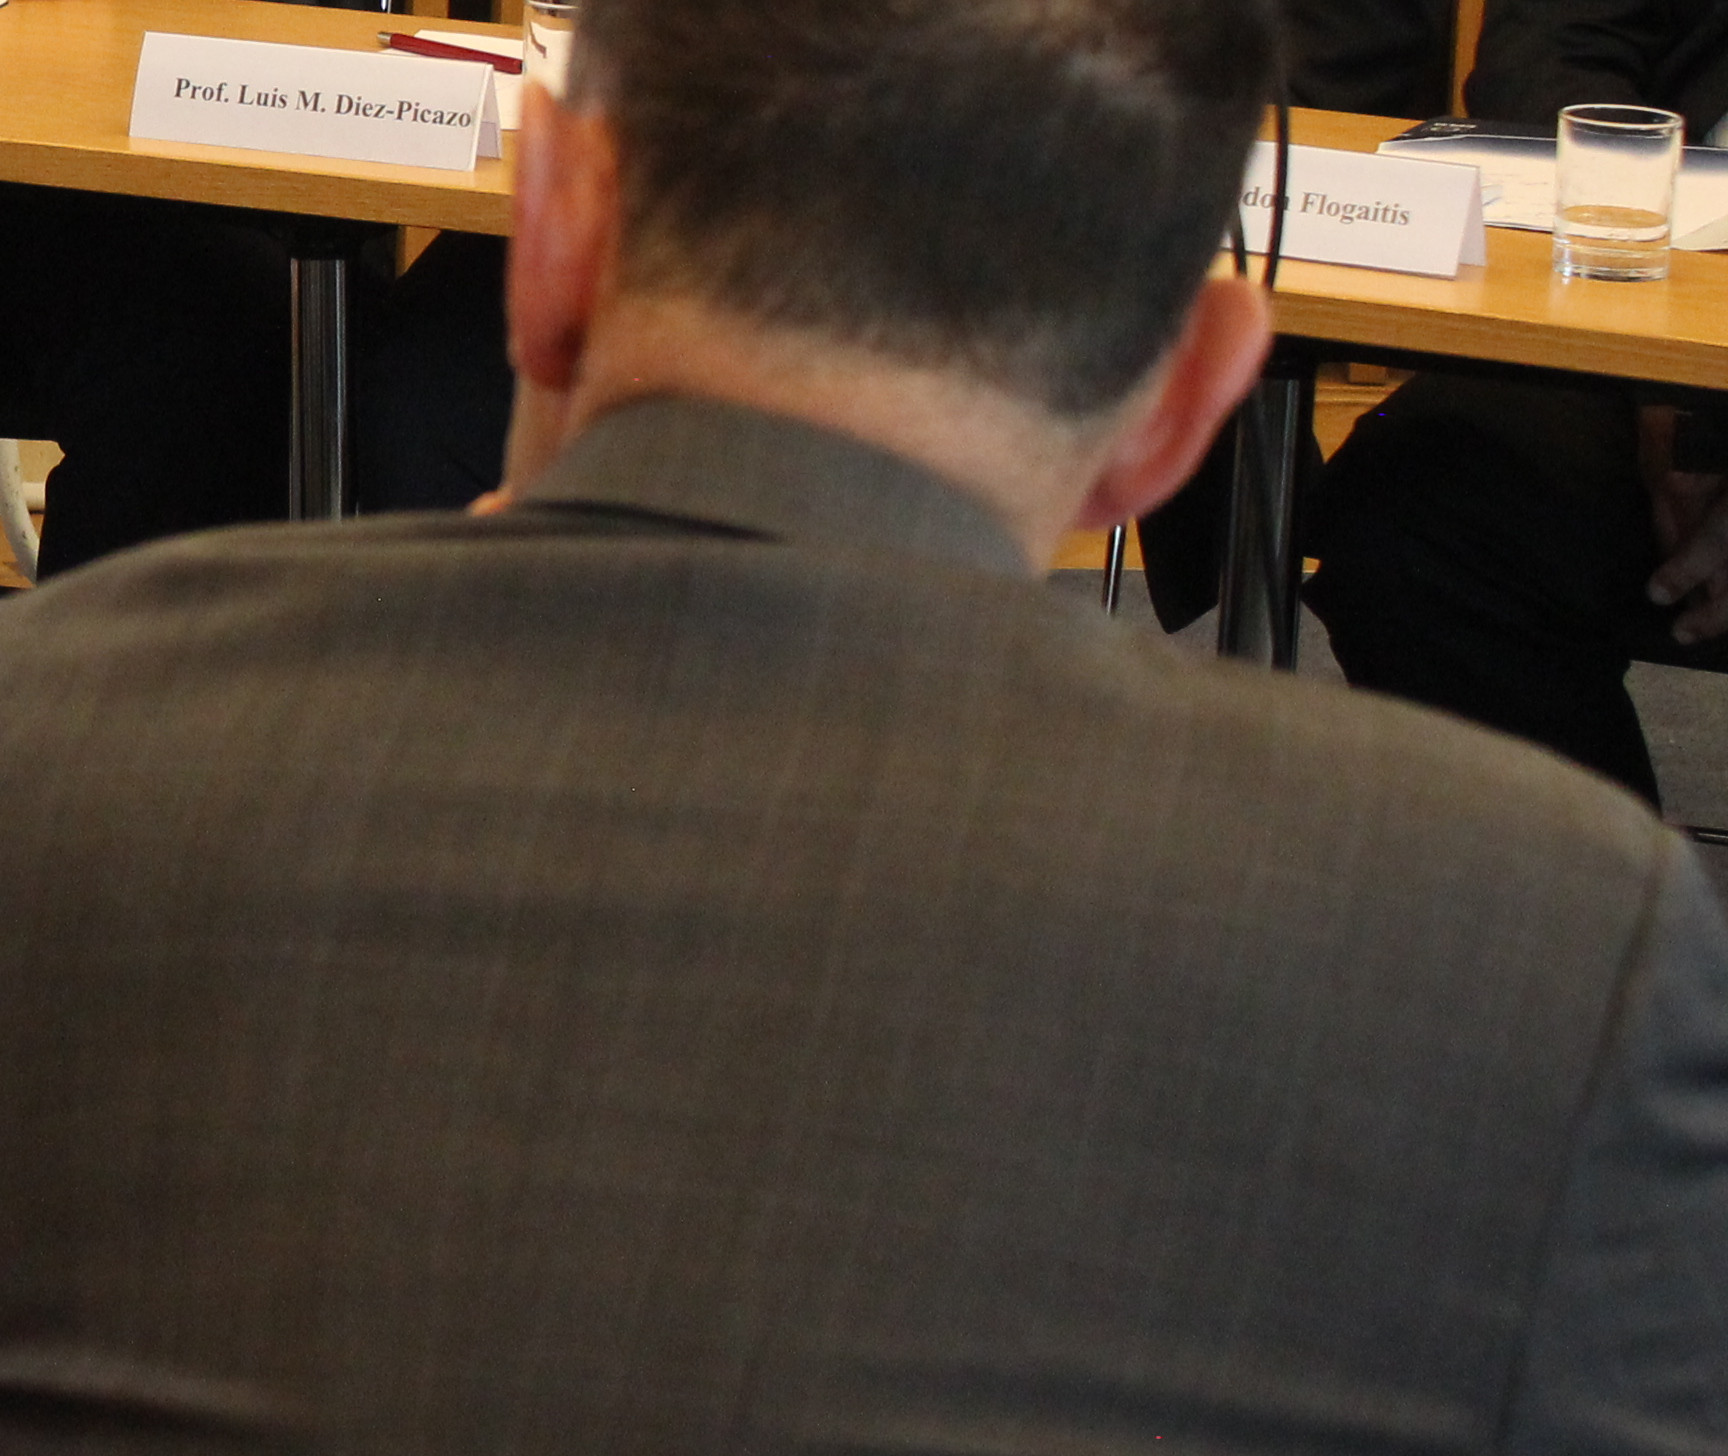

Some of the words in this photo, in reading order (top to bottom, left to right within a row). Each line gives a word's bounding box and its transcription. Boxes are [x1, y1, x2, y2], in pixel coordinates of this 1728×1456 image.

[173, 77, 230, 103] Prof.
[237, 84, 289, 110] Luis
[295, 89, 327, 113] M.
[334, 94, 472, 128] Diez-Picazo
[1299, 192, 1411, 226] Flogaitis
